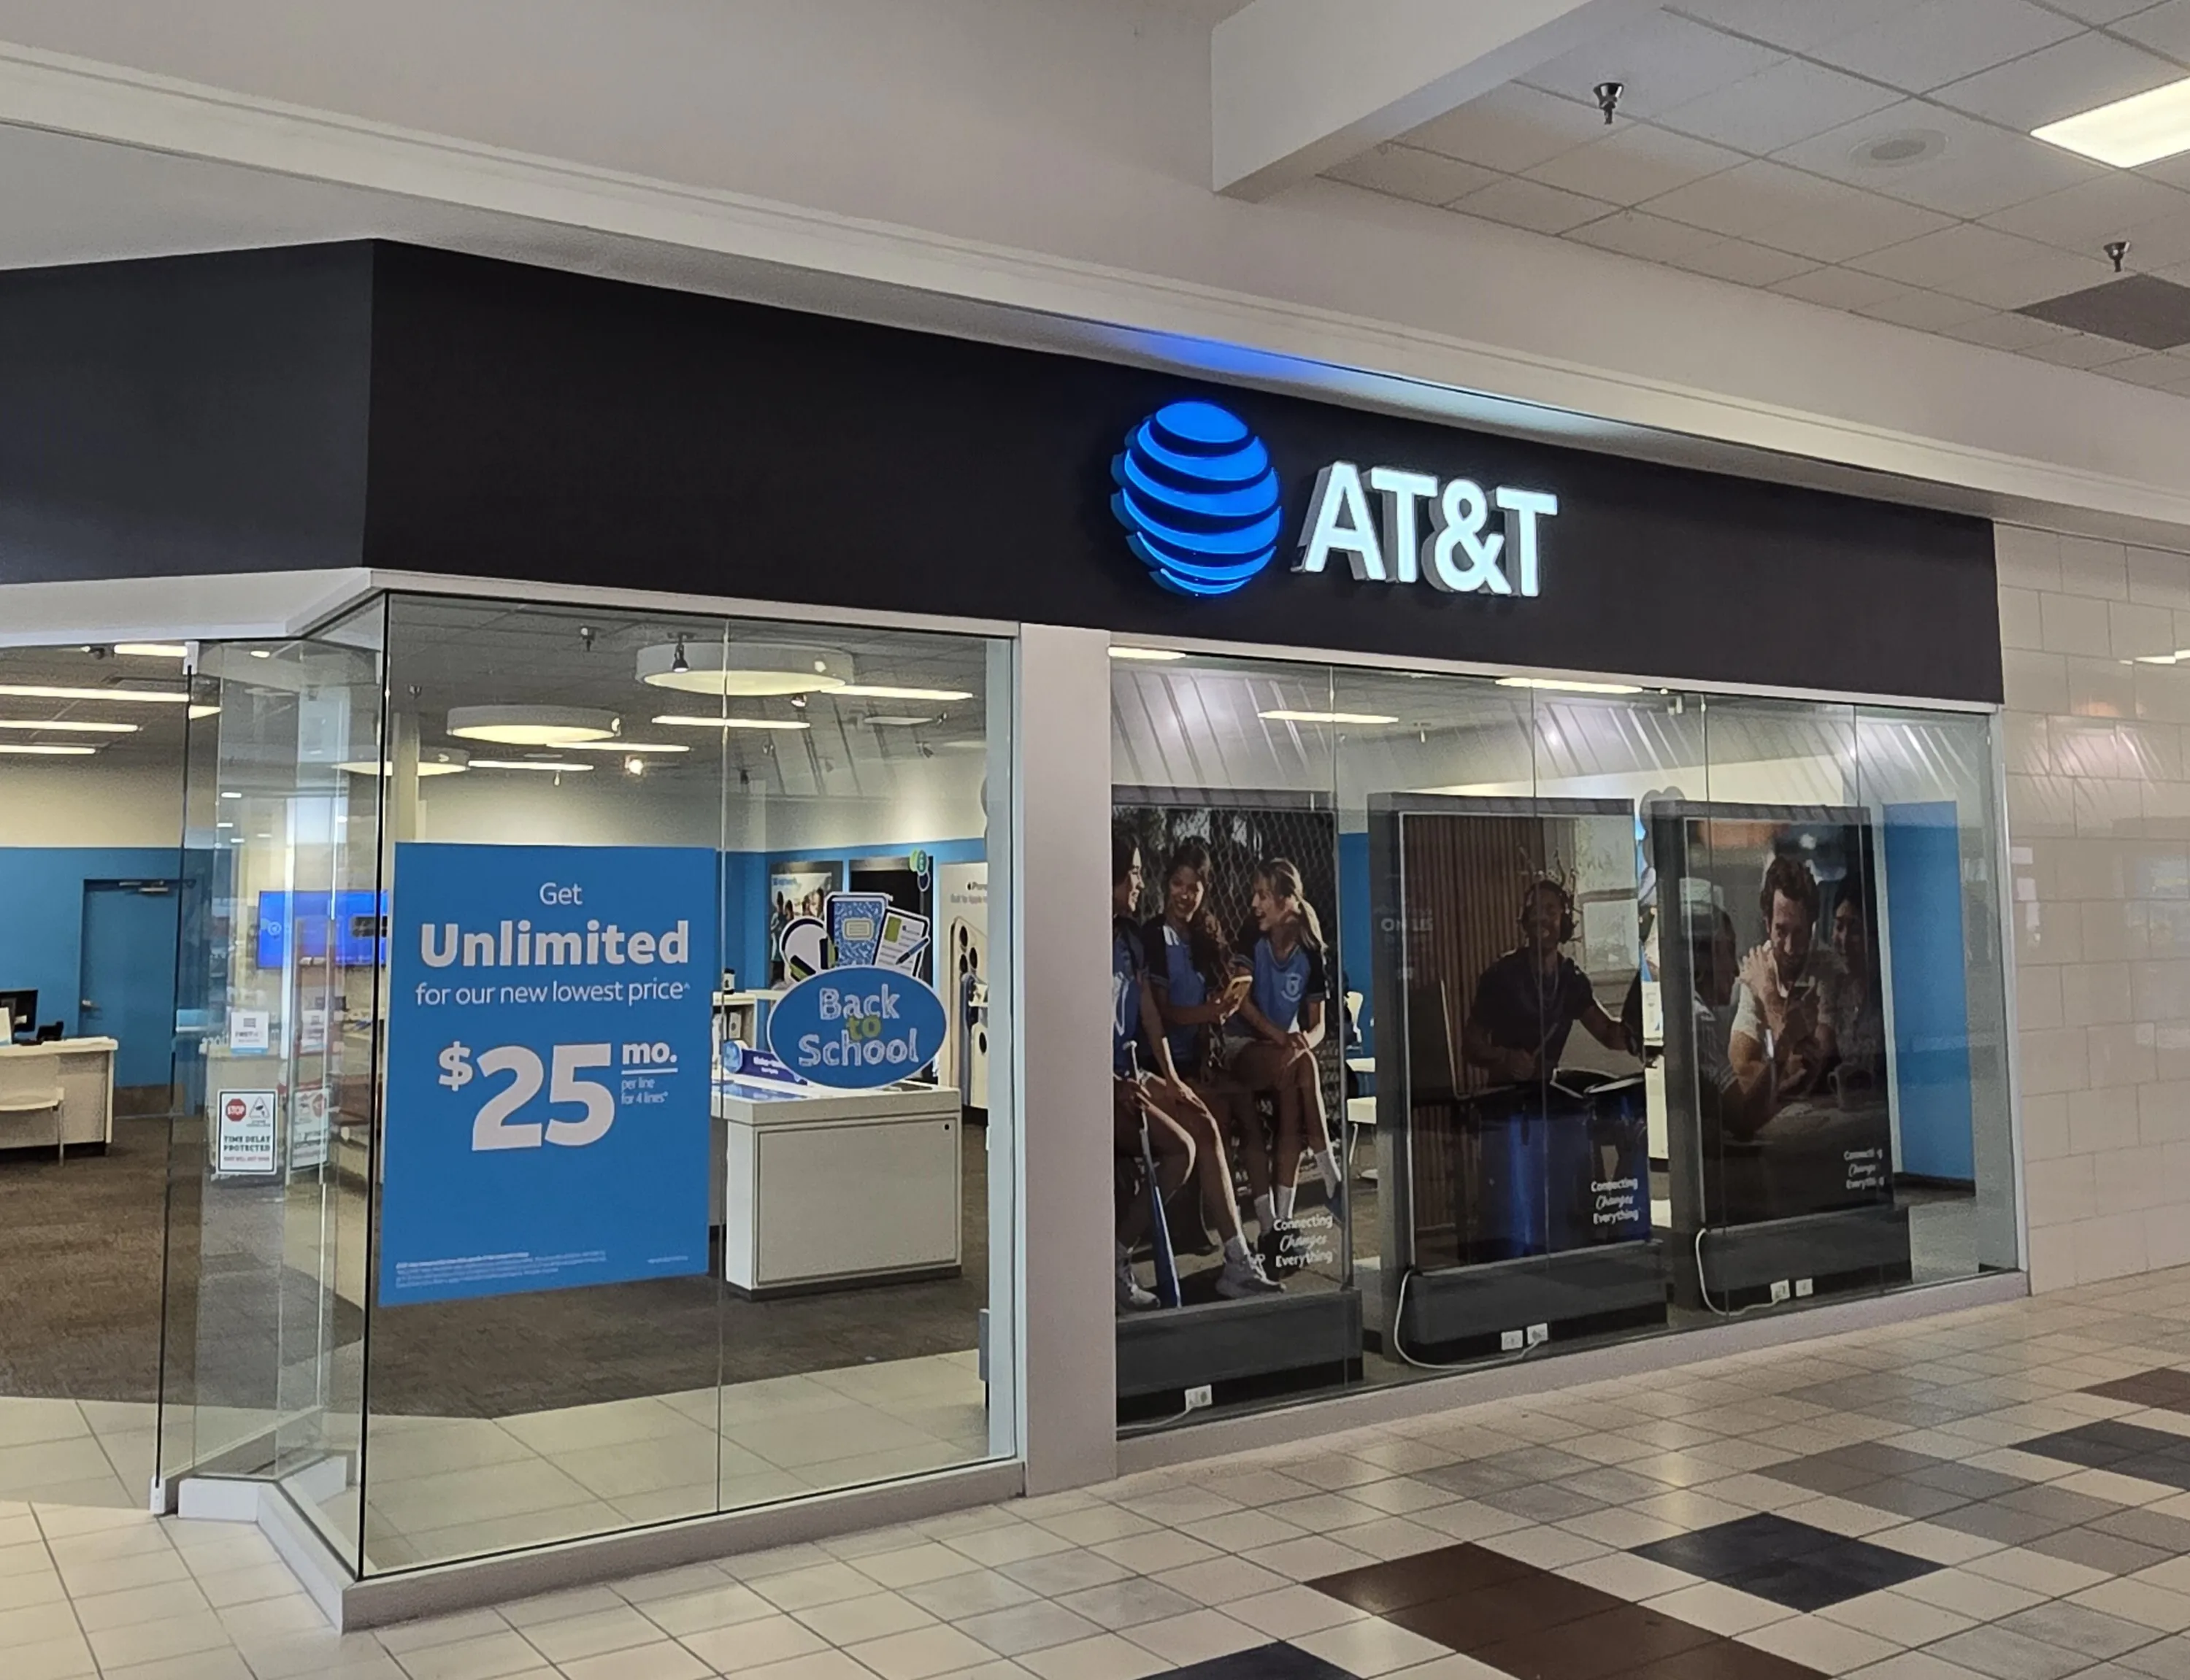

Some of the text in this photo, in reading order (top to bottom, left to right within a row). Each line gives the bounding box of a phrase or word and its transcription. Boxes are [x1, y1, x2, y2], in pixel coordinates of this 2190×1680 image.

[1294, 461, 1558, 597] AT&T
[539, 882, 583, 905] Get
[420, 920, 689, 968] Unlimited
[415, 982, 450, 1006] for
[456, 987, 496, 1005] our
[500, 985, 548, 1003] new
[553, 980, 623, 1002] lowest
[819, 983, 901, 1020] Back
[845, 1014, 882, 1041] to
[622, 1042, 677, 1065] mo.
[798, 1028, 919, 1067] School
[621, 1079, 637, 1093] per
[227, 1105, 245, 1115] STOP
[223, 1135, 271, 1143] TIME DELAY
[1273, 1214, 1333, 1231] Connecting
[1275, 1249, 1333, 1268] Everything
